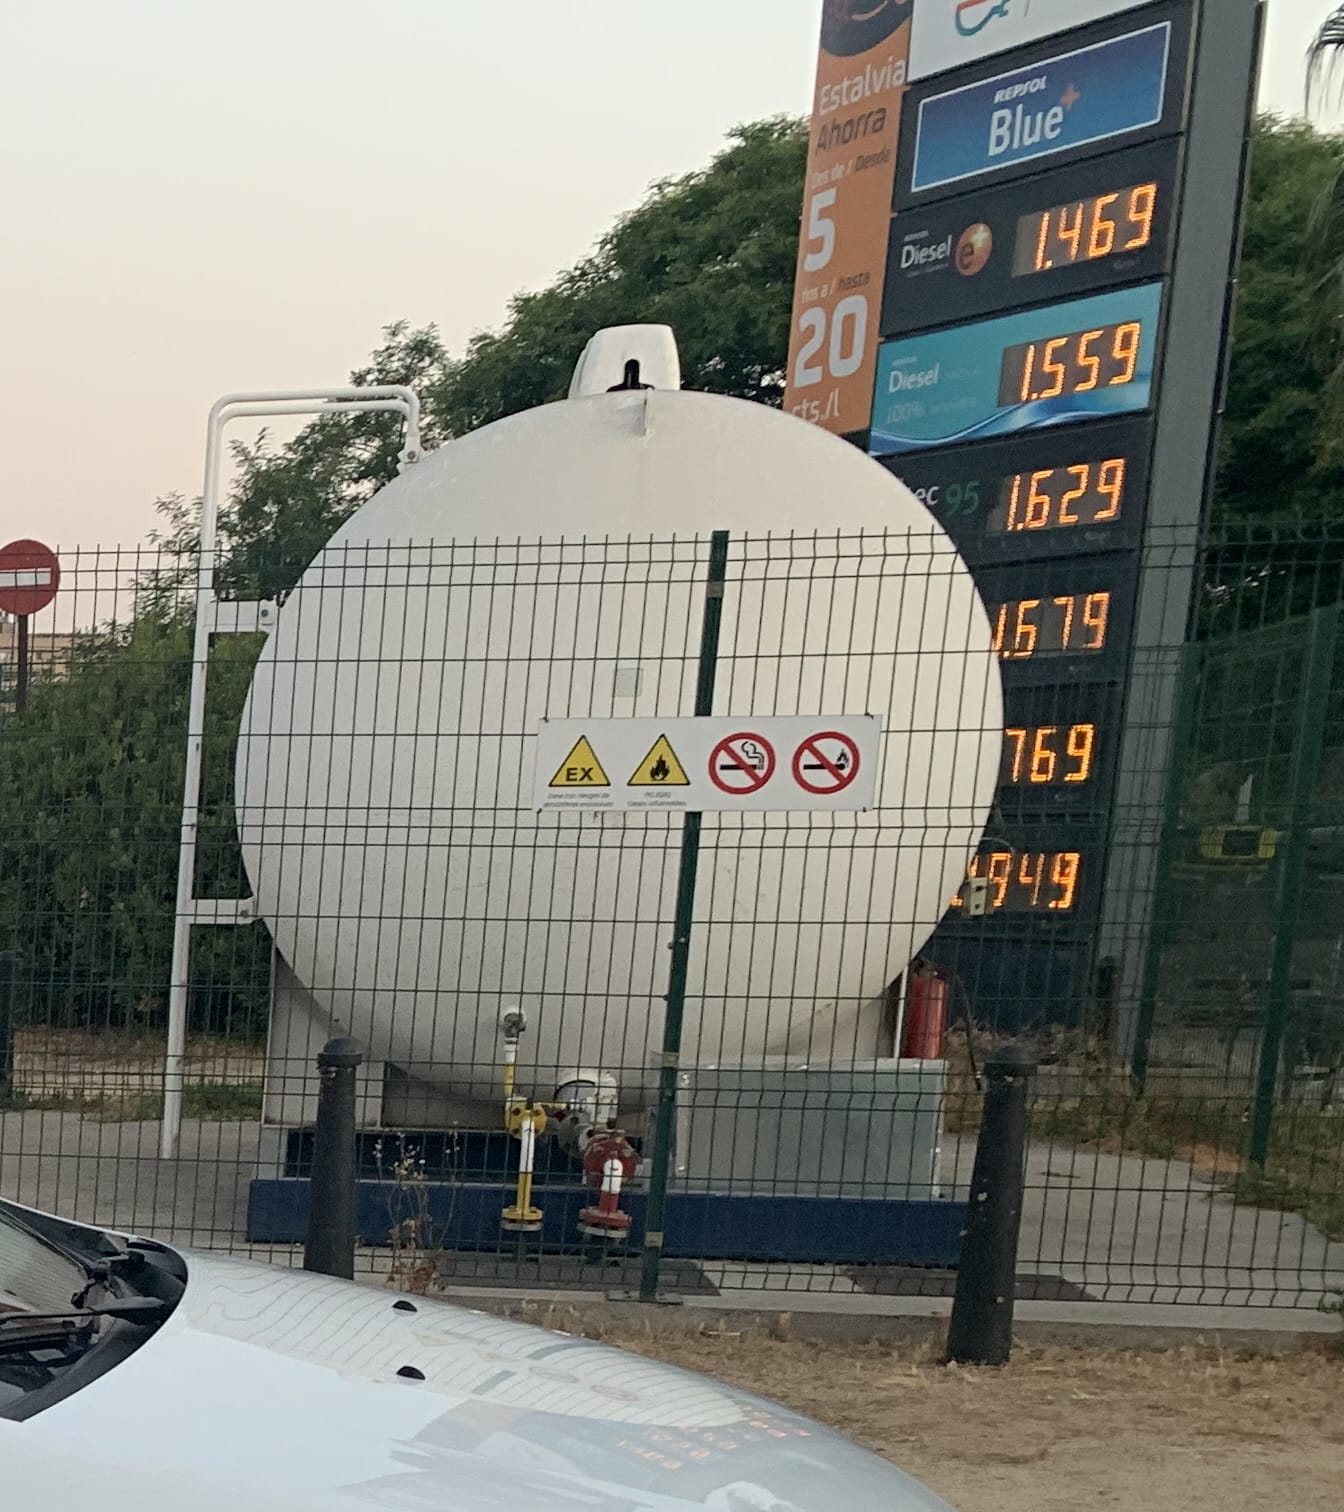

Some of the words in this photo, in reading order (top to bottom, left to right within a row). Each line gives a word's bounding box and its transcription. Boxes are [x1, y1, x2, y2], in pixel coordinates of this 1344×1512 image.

[819, 56, 906, 116] Estalvia
[994, 75, 1047, 104] REPSOL
[815, 107, 887, 155] Ahorra
[803, 186, 838, 272] 5
[900, 234, 952, 269] Diesel
[1034, 183, 1157, 271] 1.469
[794, 294, 869, 389] 20
[1020, 322, 1142, 402] 1.559
[888, 364, 940, 393] Diesel
[1007, 457, 1125, 532] 1.629
[993, 591, 1111, 658] 1.679
[565, 767, 595, 782] EX
[1005, 723, 1094, 782] 769
